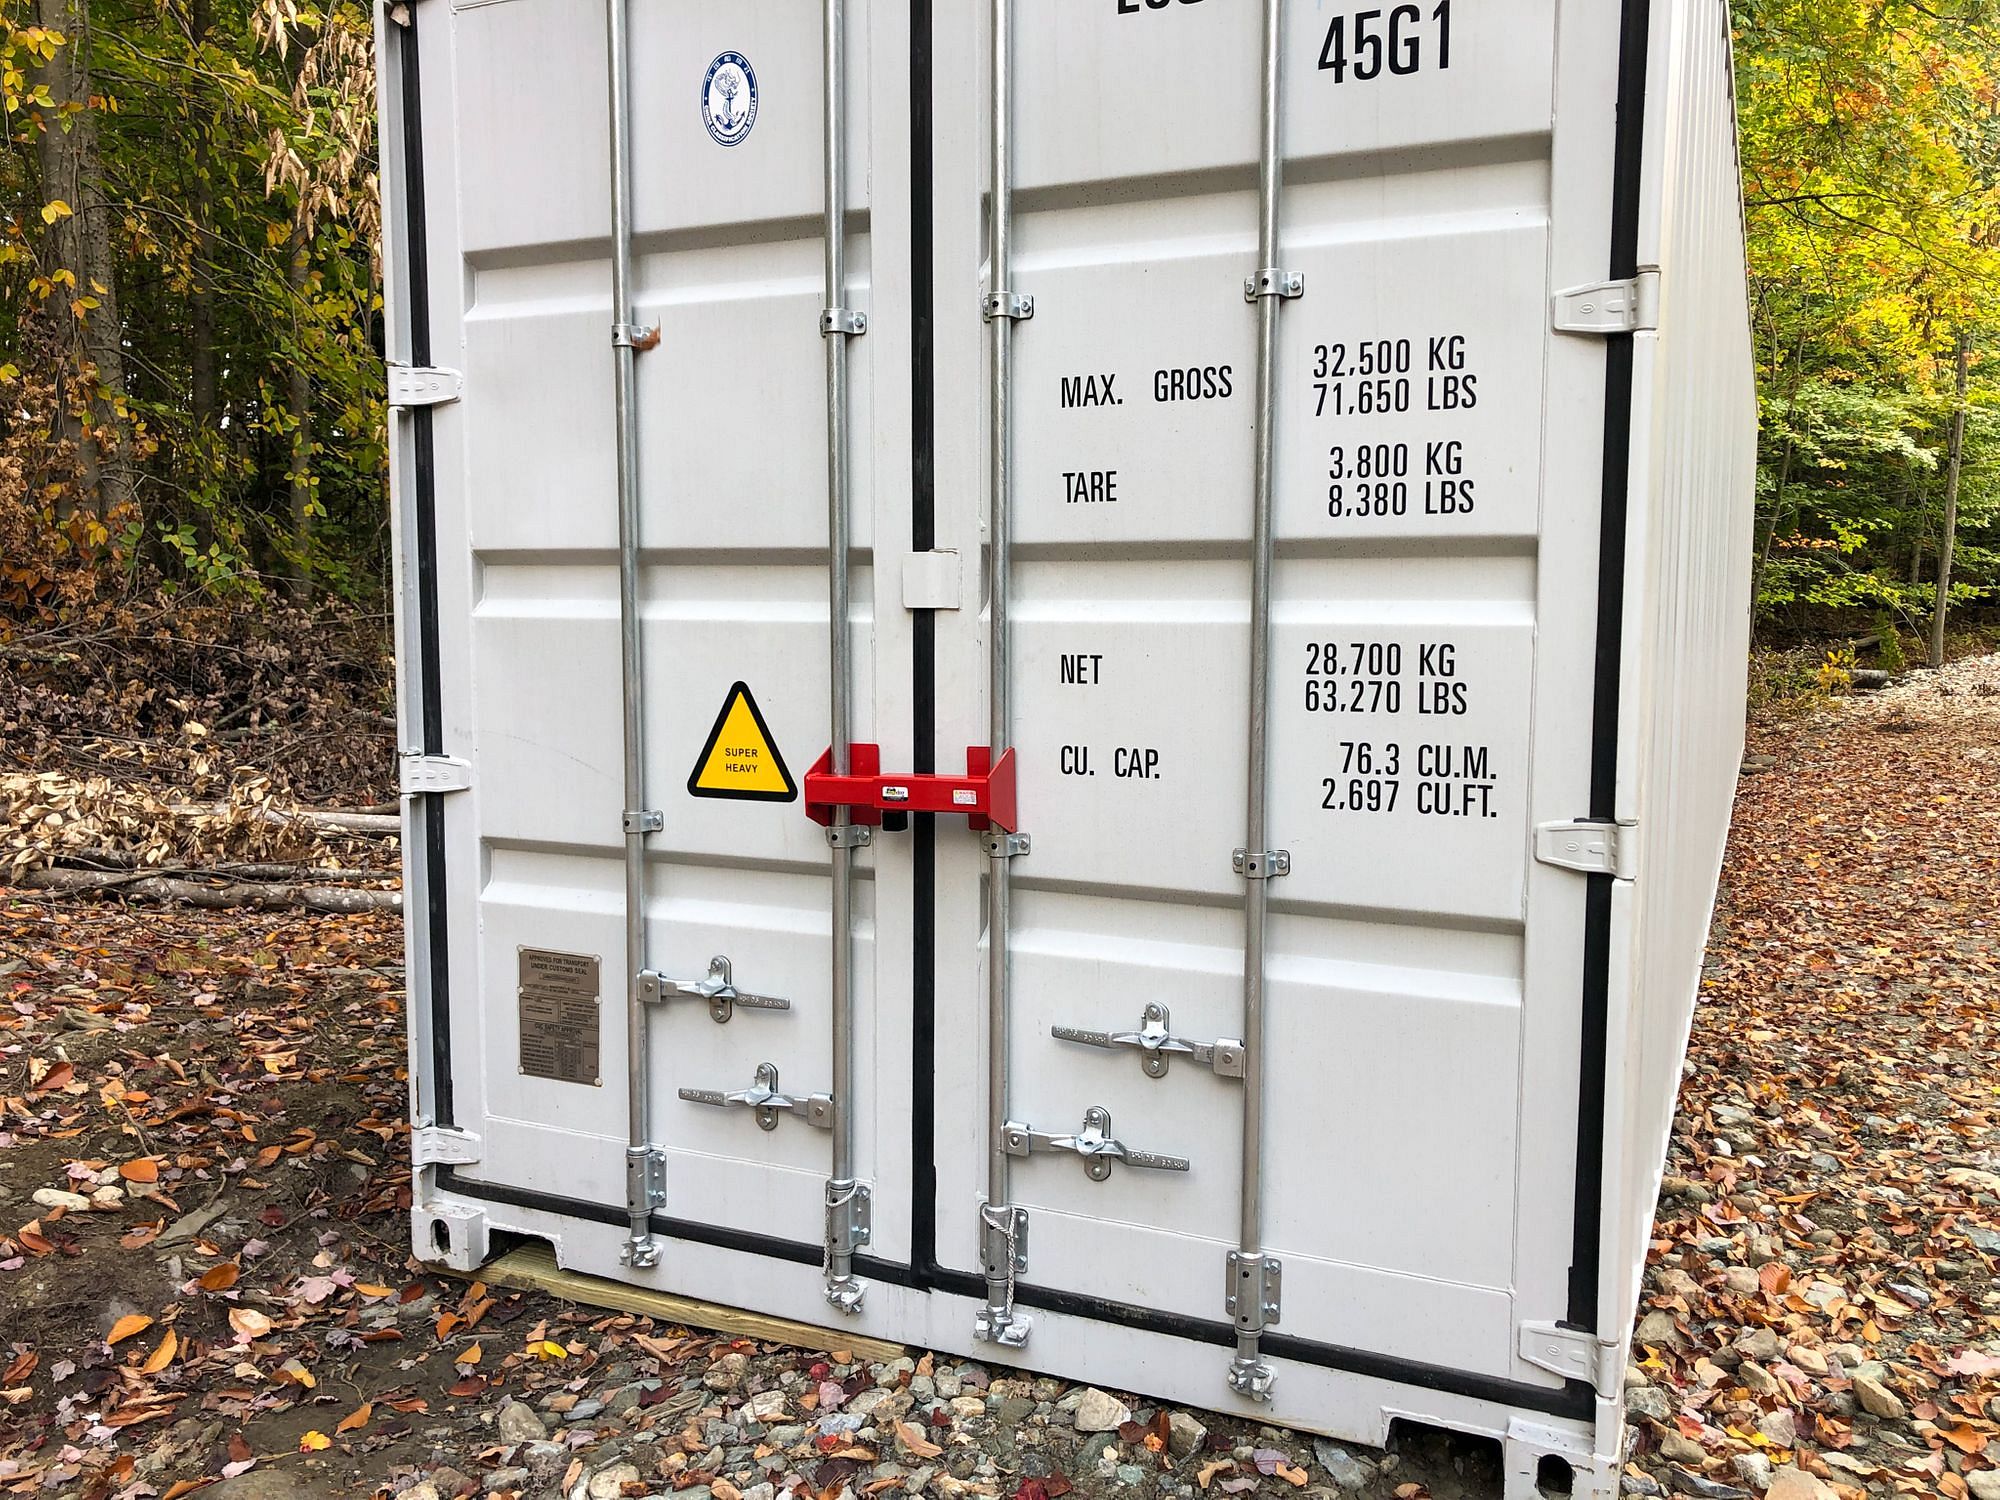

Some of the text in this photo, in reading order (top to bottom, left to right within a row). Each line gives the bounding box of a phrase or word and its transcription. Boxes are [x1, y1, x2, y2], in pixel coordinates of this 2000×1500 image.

[1317, 0, 1450, 84] 45G1
[1313, 335, 1465, 377] 32,500 KG
[1061, 365, 1233, 409] MAX. GROSS
[1313, 374, 1477, 417] 71,650 LBS
[1329, 440, 1462, 480] 3,800 KG
[1062, 470, 1117, 504] TARE
[1328, 479, 1475, 518] 8,380 LBS
[1060, 654, 1103, 685] NET
[1305, 642, 1455, 677] 28,700 KG
[1305, 679, 1467, 715] 63,270 LBS
[725, 747, 758, 758] SUPER
[725, 763, 758, 773] HEAVY
[1060, 745, 1160, 779] CU. CAP.
[1339, 741, 1497, 780] 76.3 CU.M.
[1321, 778, 1497, 818] 2,697 CU.FT.
